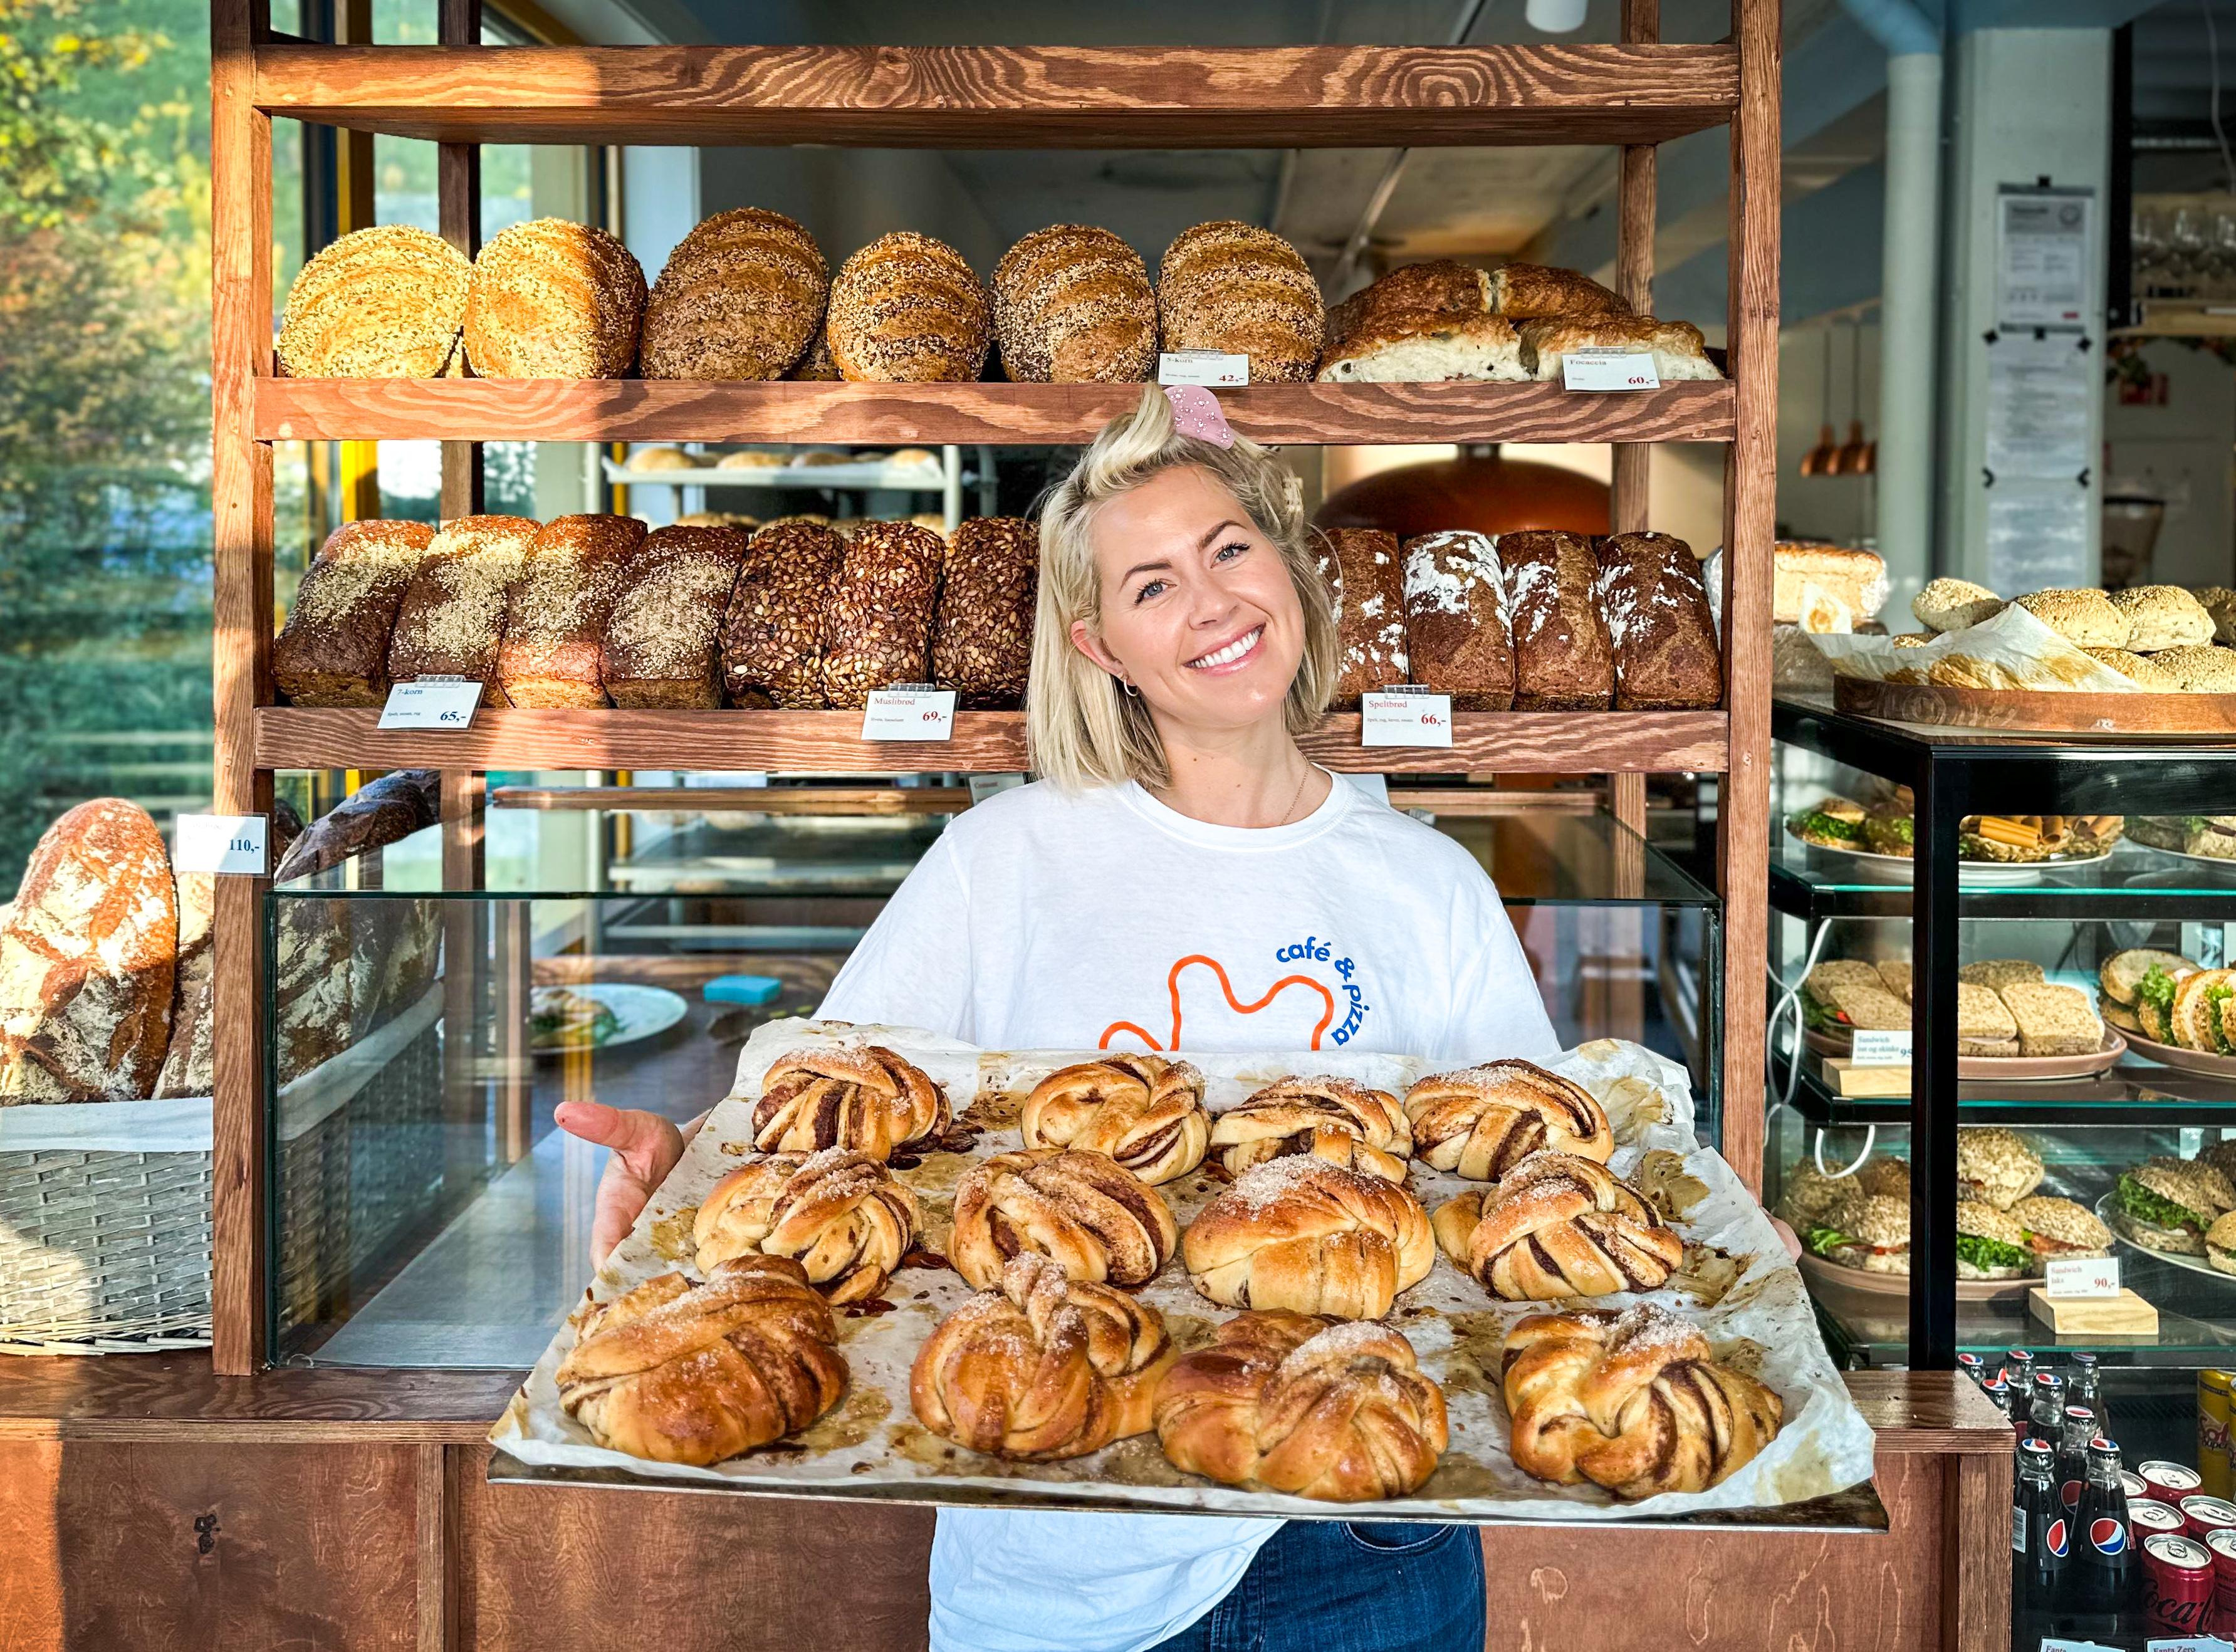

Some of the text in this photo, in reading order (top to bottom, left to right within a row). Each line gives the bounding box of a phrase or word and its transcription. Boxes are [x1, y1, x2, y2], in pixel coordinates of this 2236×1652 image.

[1628, 377, 1655, 385] 60,-
[1368, 700, 1408, 709] Speltbrød
[440, 711, 467, 723] 65,-
[922, 711, 948, 723] 69,-
[1420, 713, 1446, 727] 66,-
[229, 839, 260, 854] 110,-
[1276, 936, 1370, 1046] café & pizza
[2051, 1266, 2083, 1275] Sandwich
[2094, 1278, 2116, 1290] 90,-
